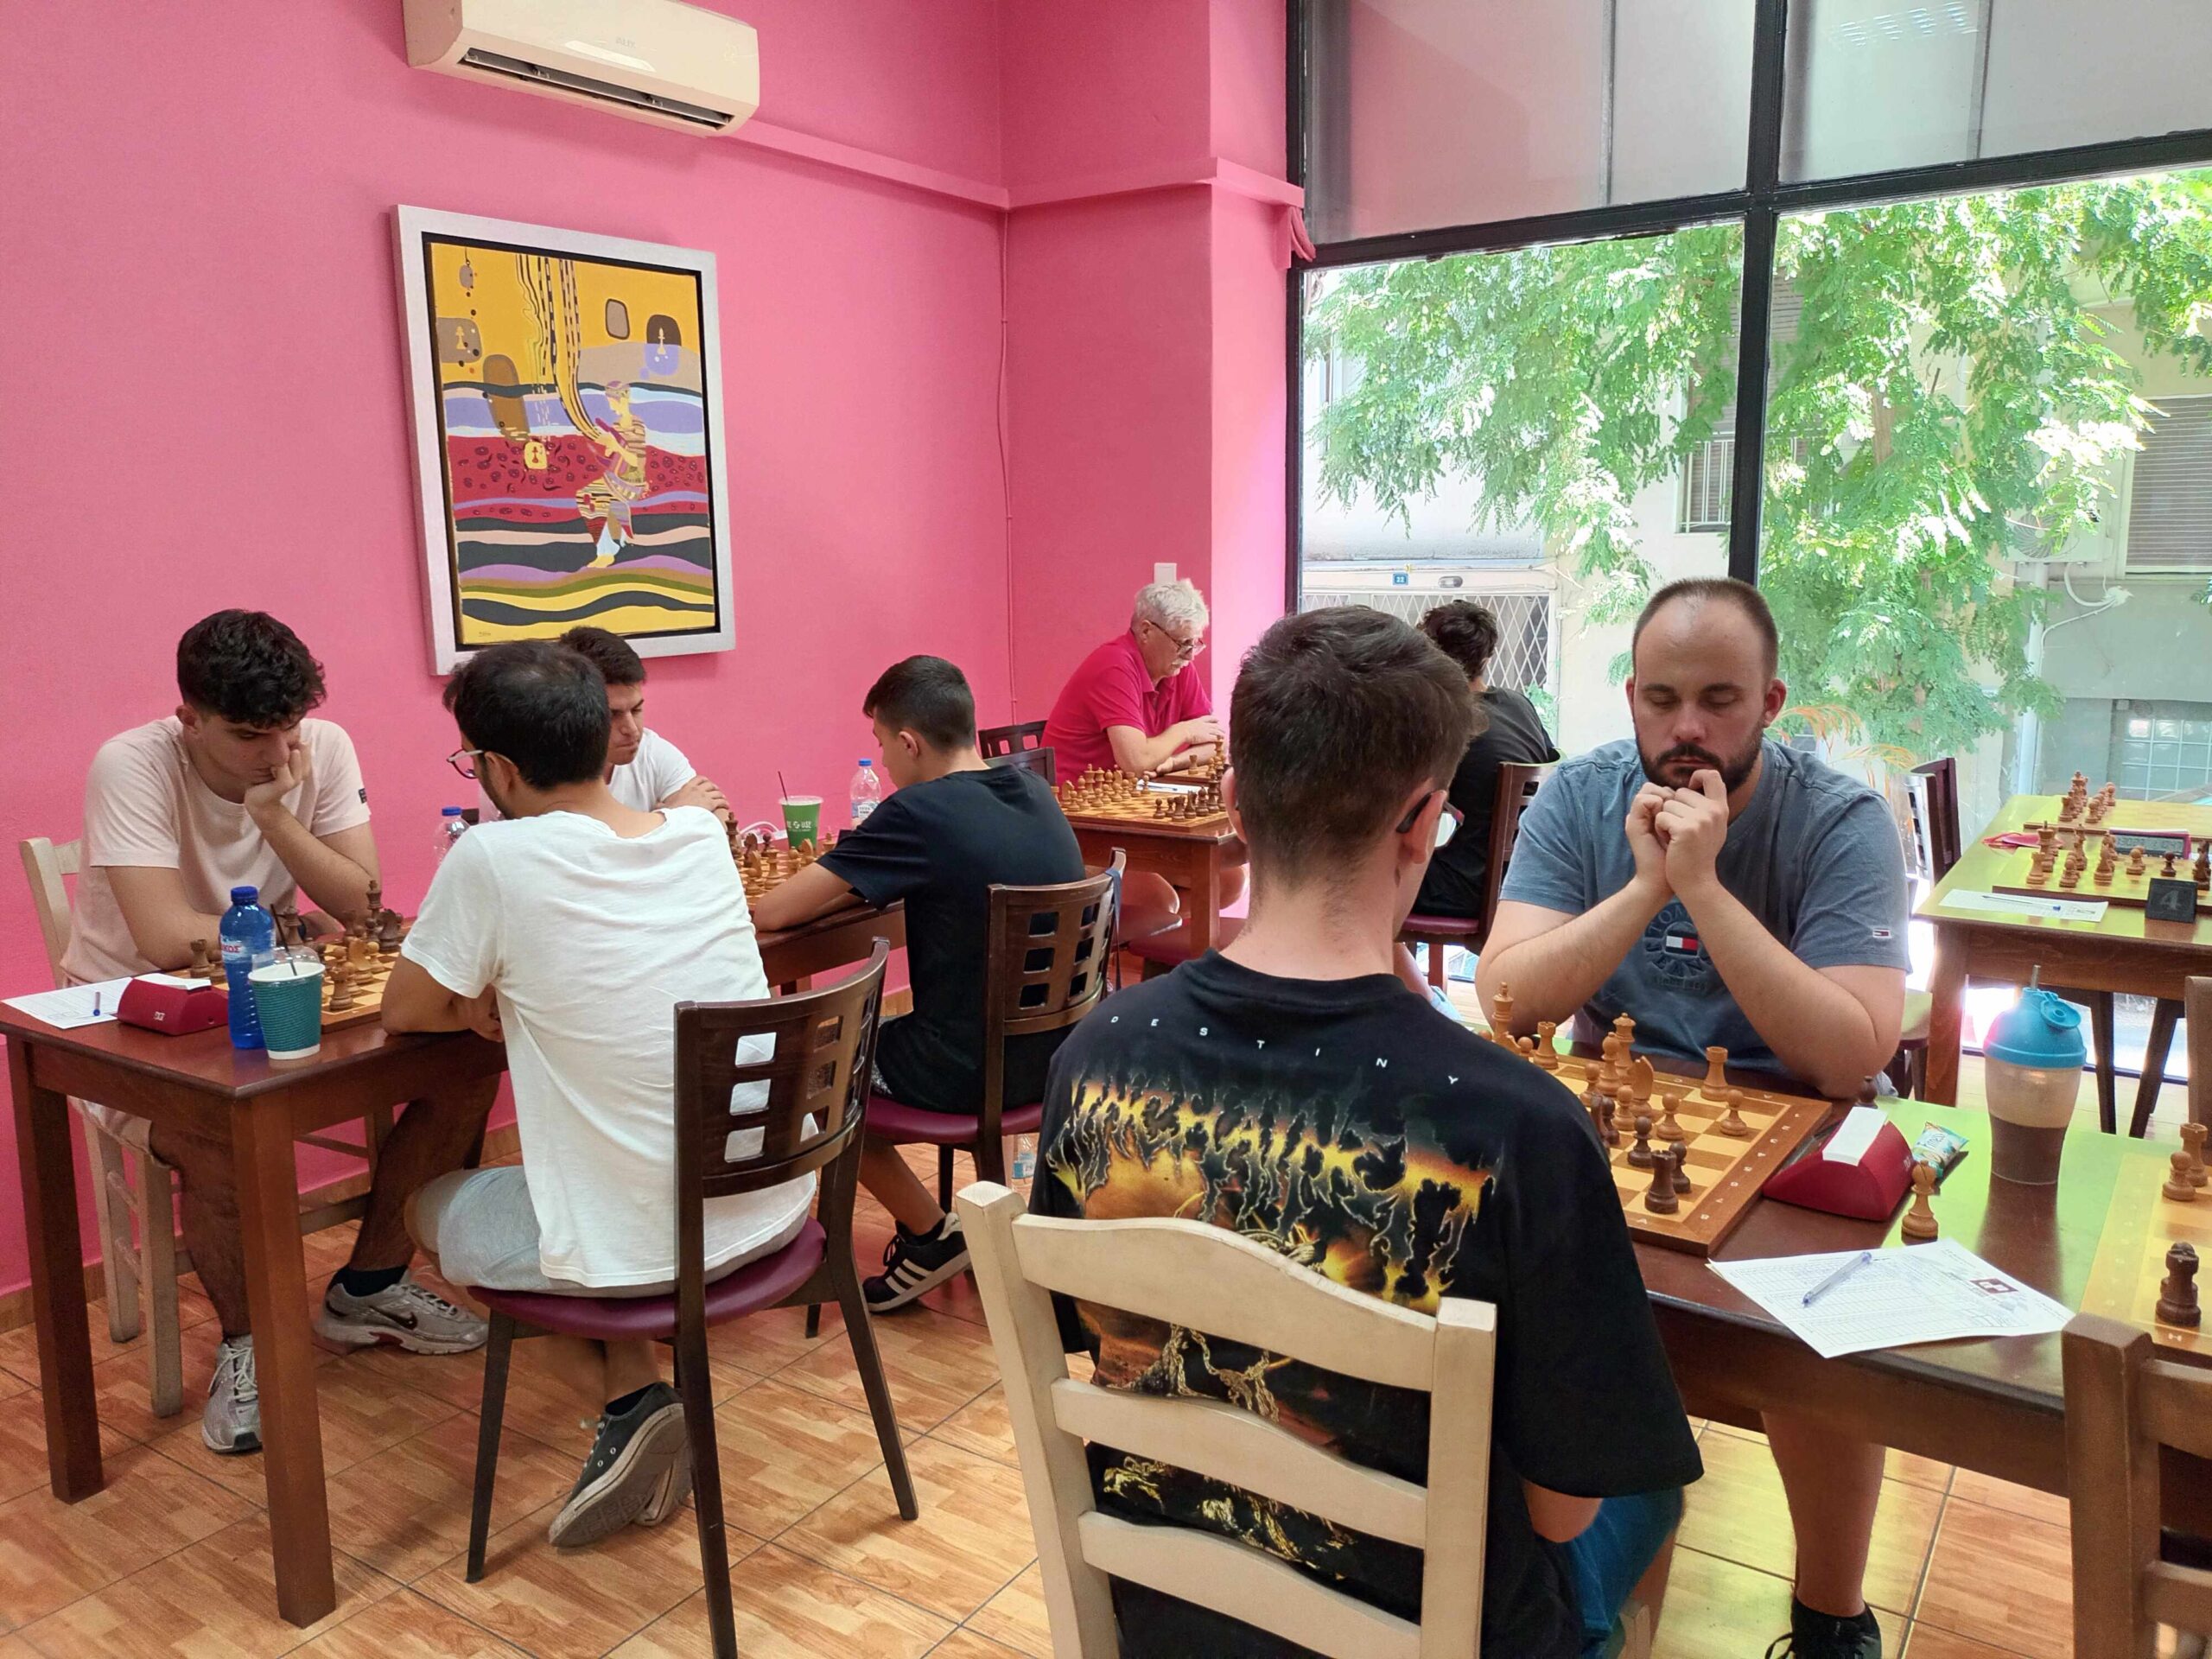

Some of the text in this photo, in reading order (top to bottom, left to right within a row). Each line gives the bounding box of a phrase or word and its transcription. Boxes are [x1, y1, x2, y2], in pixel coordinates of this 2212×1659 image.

[615, 36, 636, 49] AUX
[2160, 889, 2182, 911] 4
[1110, 1015, 1459, 1084] DESTINY
